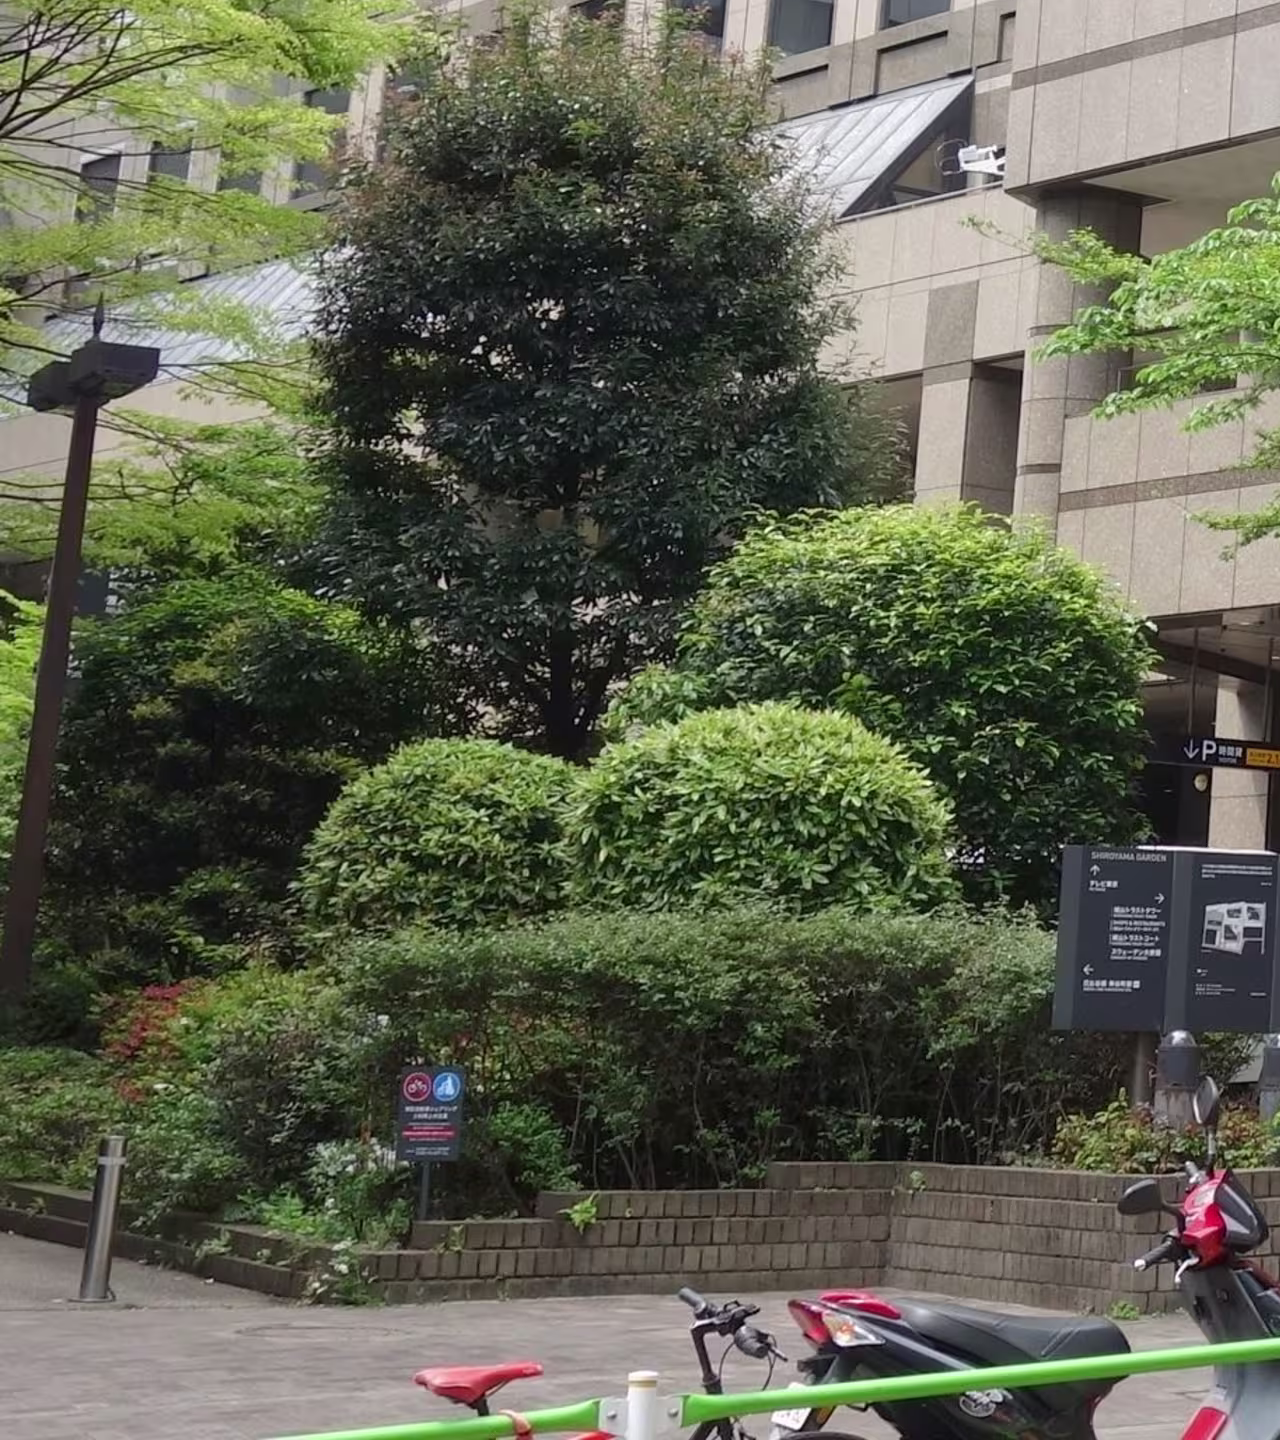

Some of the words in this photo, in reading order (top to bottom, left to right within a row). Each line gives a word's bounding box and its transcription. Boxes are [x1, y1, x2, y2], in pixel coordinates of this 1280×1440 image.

[1202, 740, 1217, 761] P
[1091, 851, 1135, 860] SHIROYAMA
[1135, 854, 1167, 862] GARDEN
